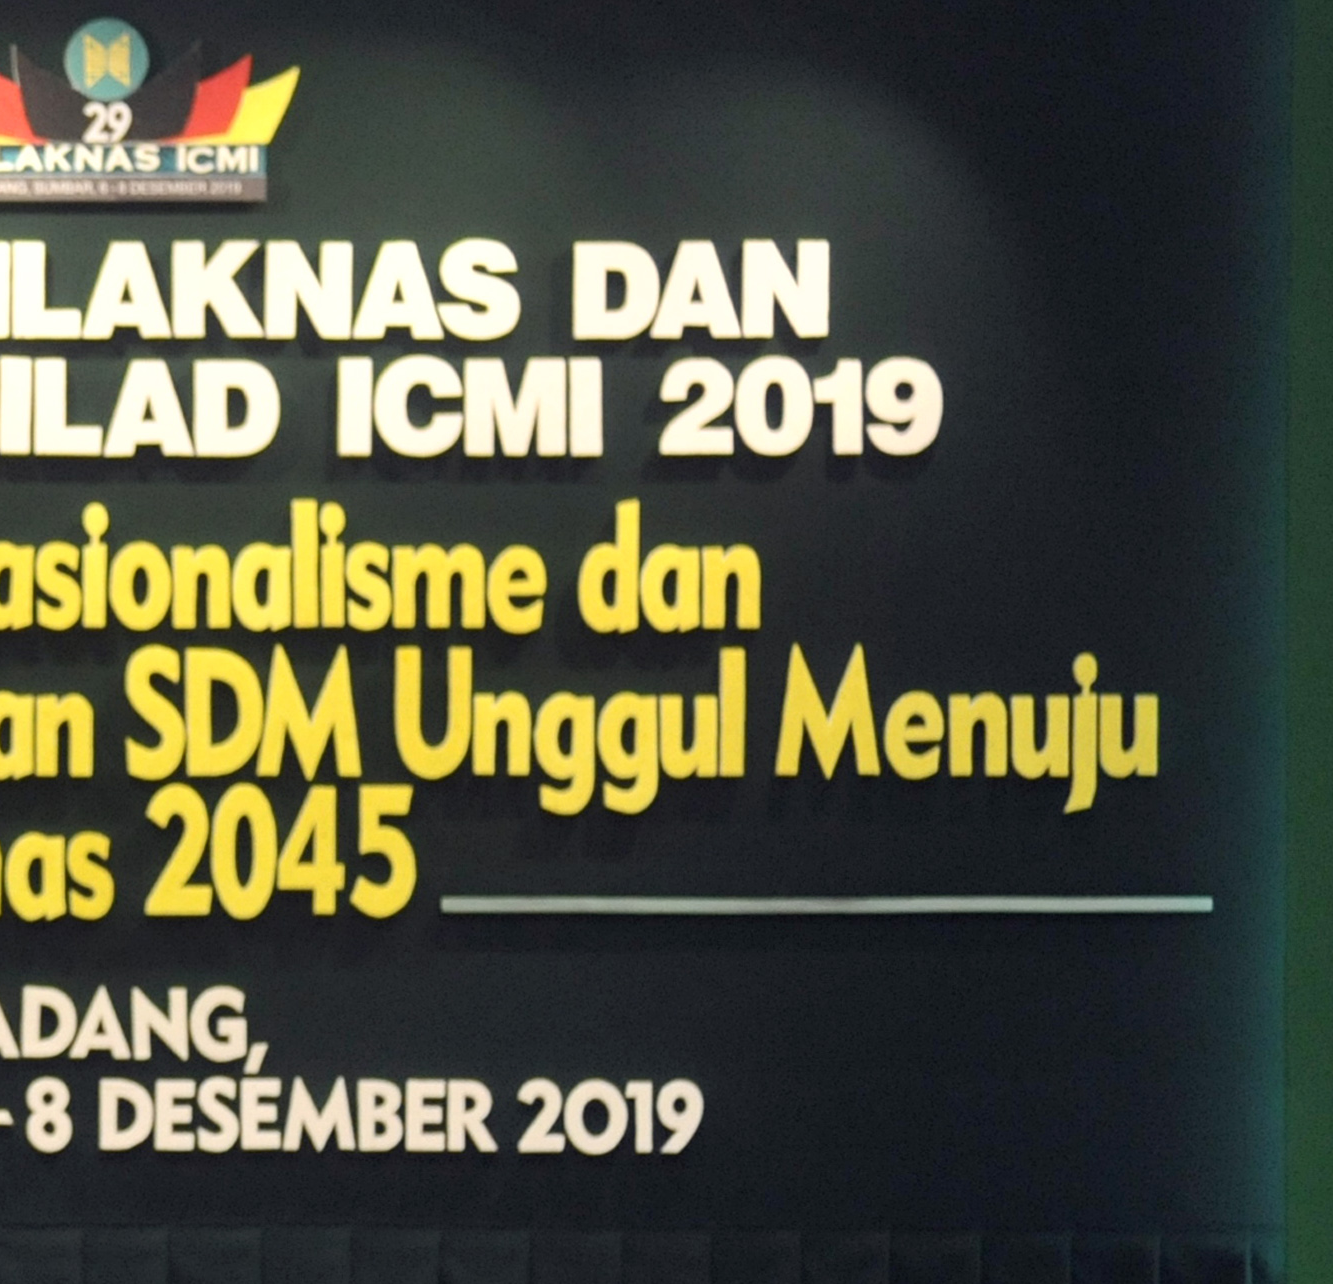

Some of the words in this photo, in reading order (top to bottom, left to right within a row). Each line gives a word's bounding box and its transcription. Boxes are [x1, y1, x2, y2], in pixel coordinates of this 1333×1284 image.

[82, 101, 132, 143] 29
[176, 144, 260, 174] ICMI
[572, 238, 831, 341] DAN
[337, 354, 604, 458] ICMI
[659, 355, 944, 457] 2019
[578, 498, 761, 633] dan
[124, 643, 362, 782] SDM
[393, 645, 746, 815] Unggul
[775, 642, 1158, 813] Menuju
[143, 783, 417, 920] 2045
[98, 1076, 498, 1153] DESEMBER
[517, 1078, 705, 1155] 2019
